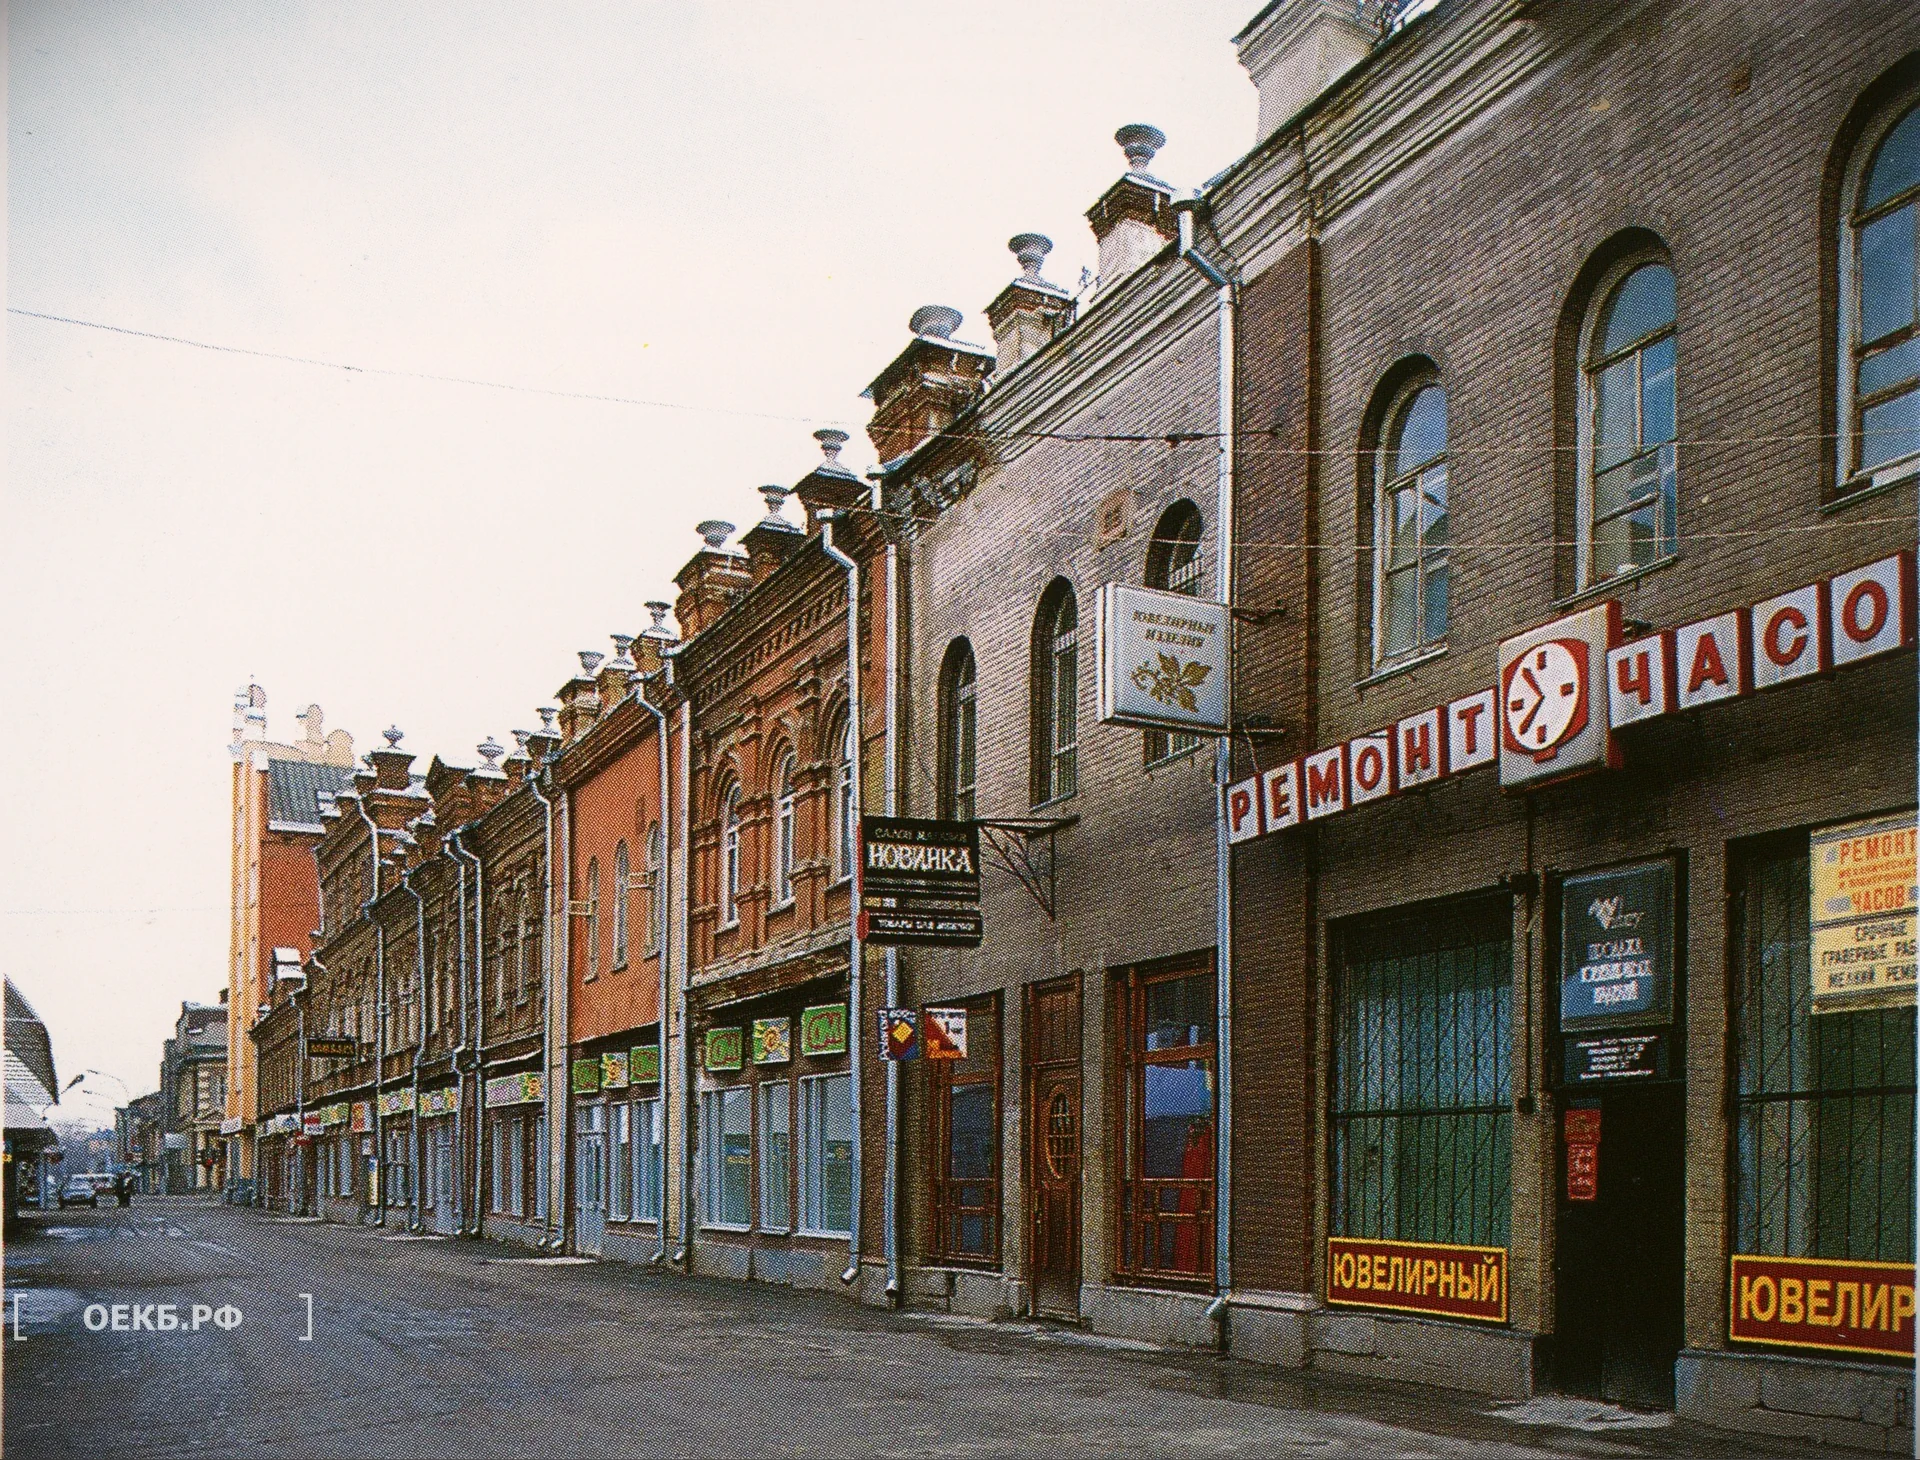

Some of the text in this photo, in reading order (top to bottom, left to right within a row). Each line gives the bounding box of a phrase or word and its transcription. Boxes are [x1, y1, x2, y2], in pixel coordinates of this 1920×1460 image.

[1231, 579, 1889, 833] РЕМОНТ ЧАСО
[866, 842, 974, 874] НОВИНКА
[1839, 828, 1917, 864] РЕМОНТ
[1851, 884, 1905, 913] ЧАСОВ
[1333, 1253, 1499, 1302] ЮВЕЛИРНЫЙ
[1740, 1275, 1916, 1332] ЮВЕЛИР
